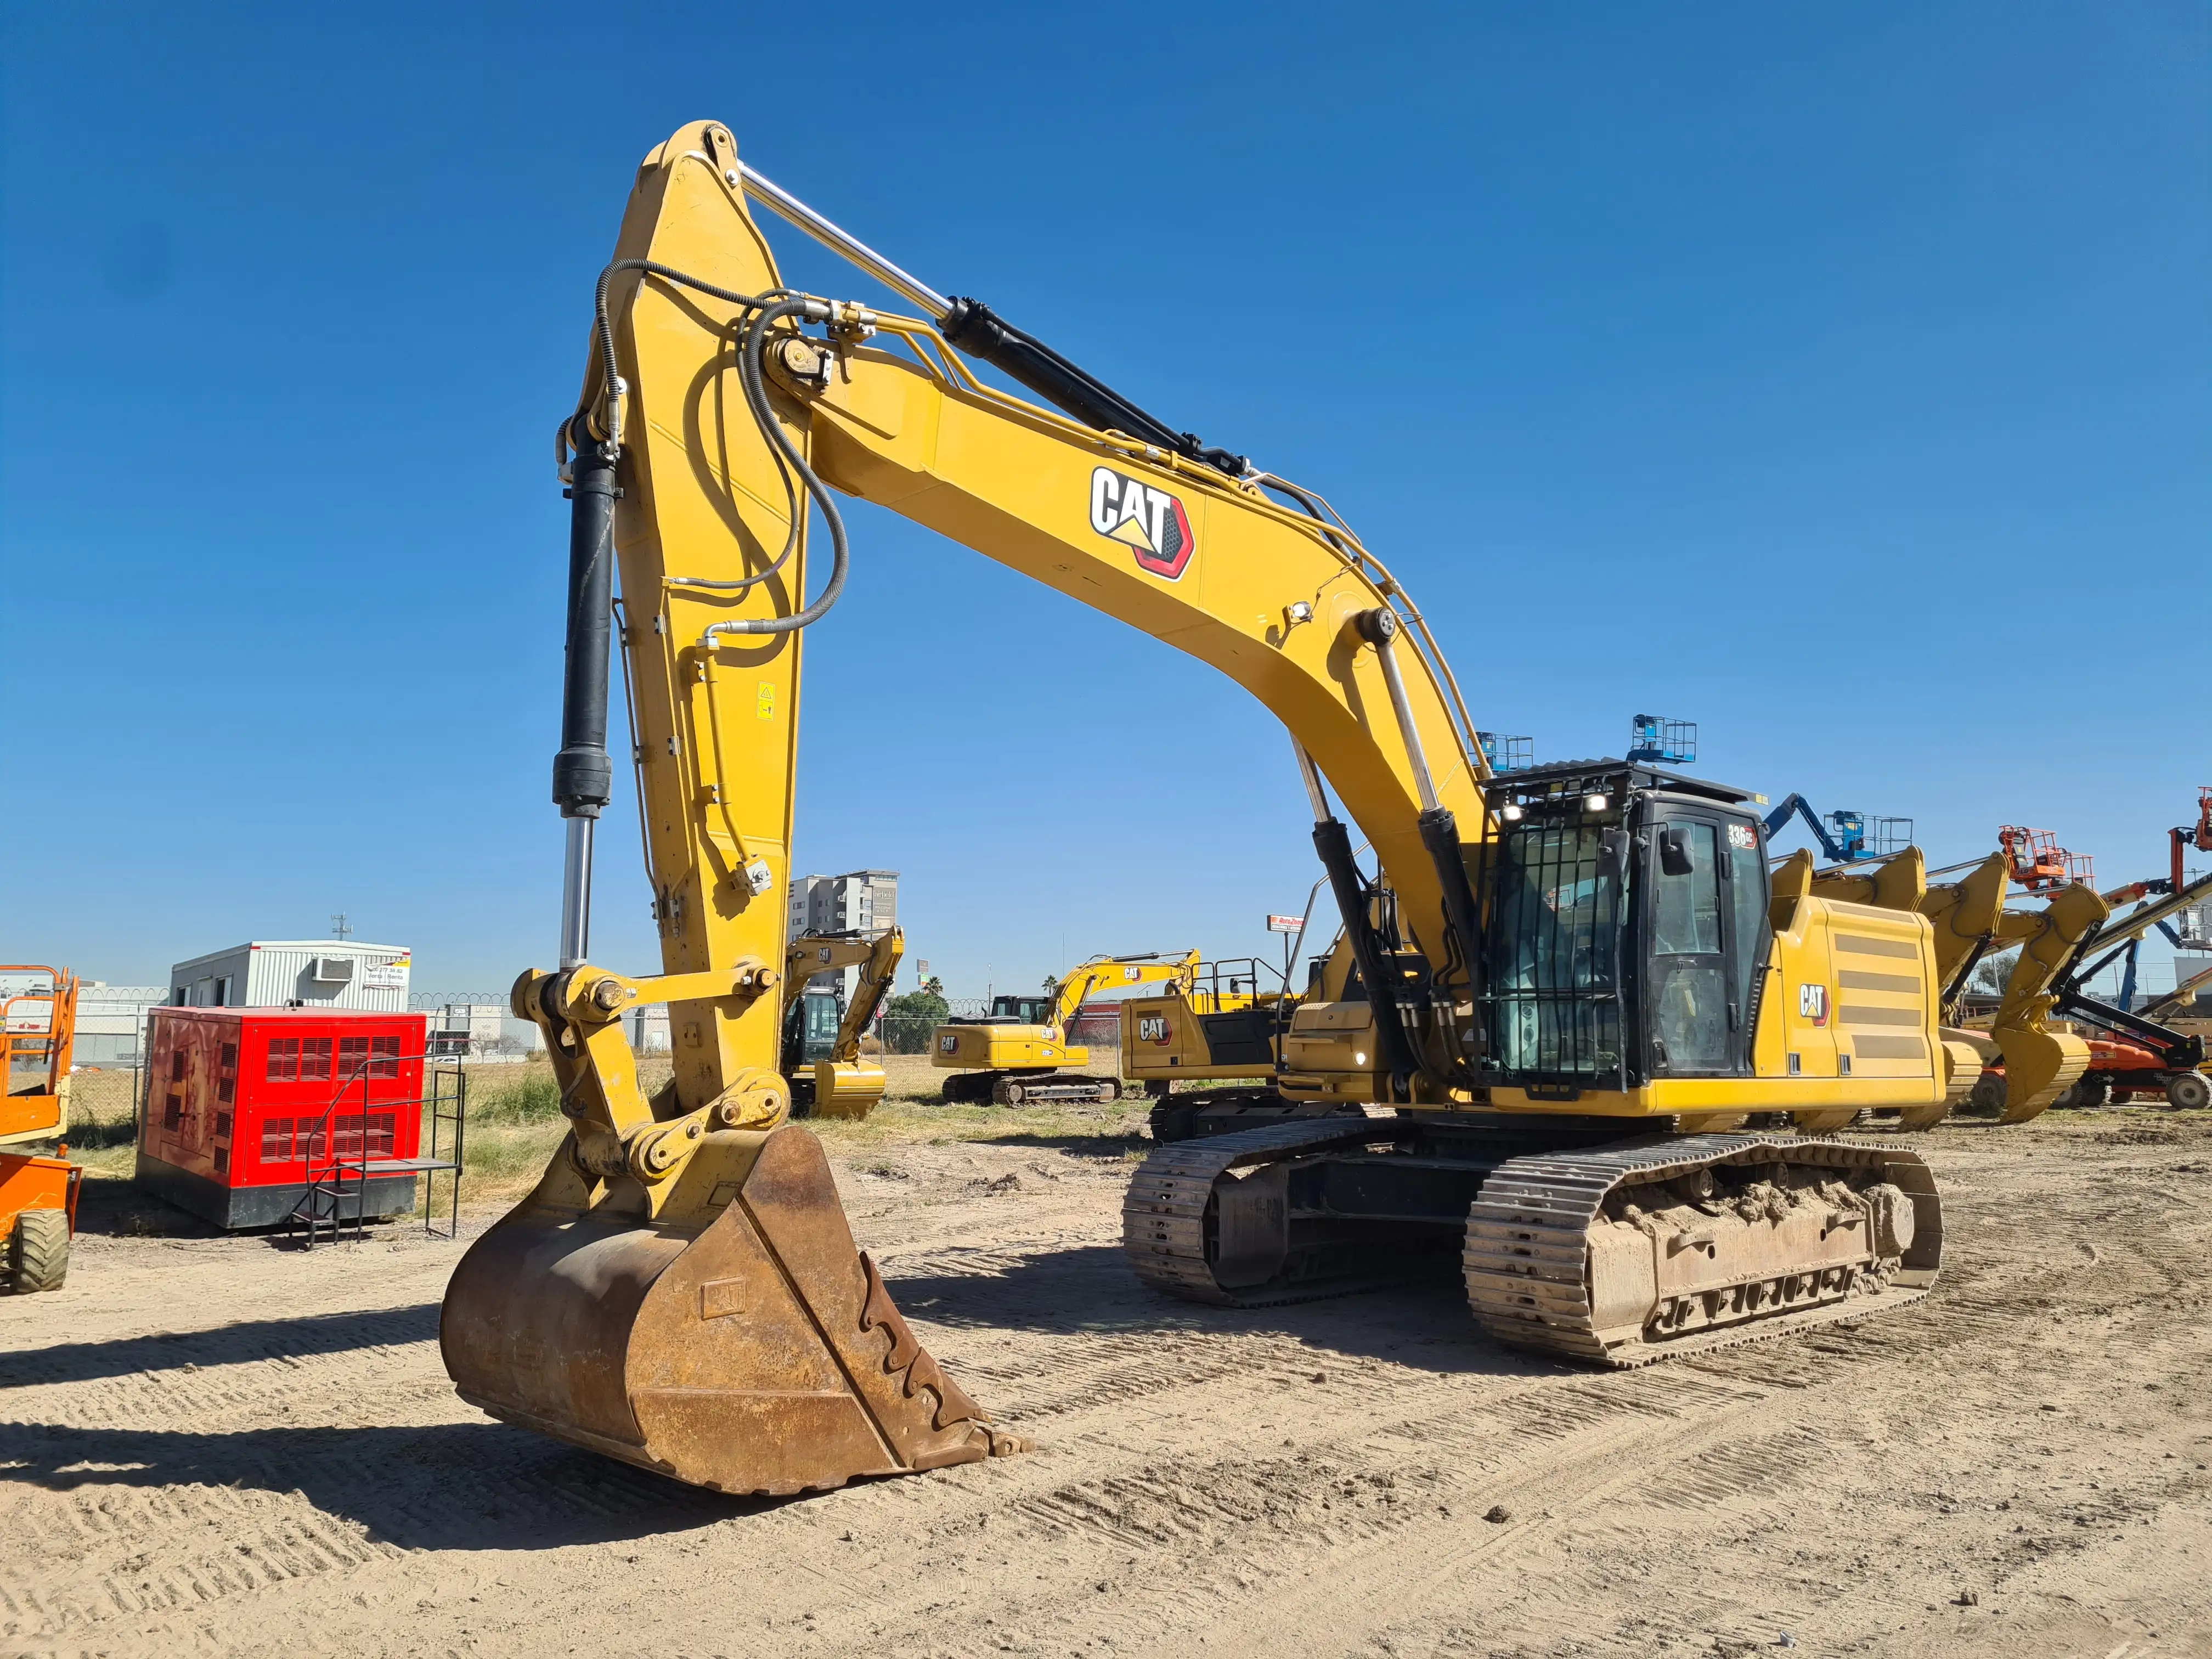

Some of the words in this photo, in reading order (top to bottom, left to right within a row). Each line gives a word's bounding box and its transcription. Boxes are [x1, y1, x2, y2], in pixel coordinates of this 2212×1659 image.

[1092, 467, 1171, 555] CAT
[1728, 824, 1746, 845] 336
[1746, 832, 1753, 843] GC
[819, 948, 829, 961] CAT
[1125, 967, 1138, 979] CAT
[1800, 984, 1823, 1017] CAT
[1041, 1029, 1053, 1039] CAT
[1141, 1018, 1164, 1040] CAT
[941, 1036, 955, 1050] CAT
